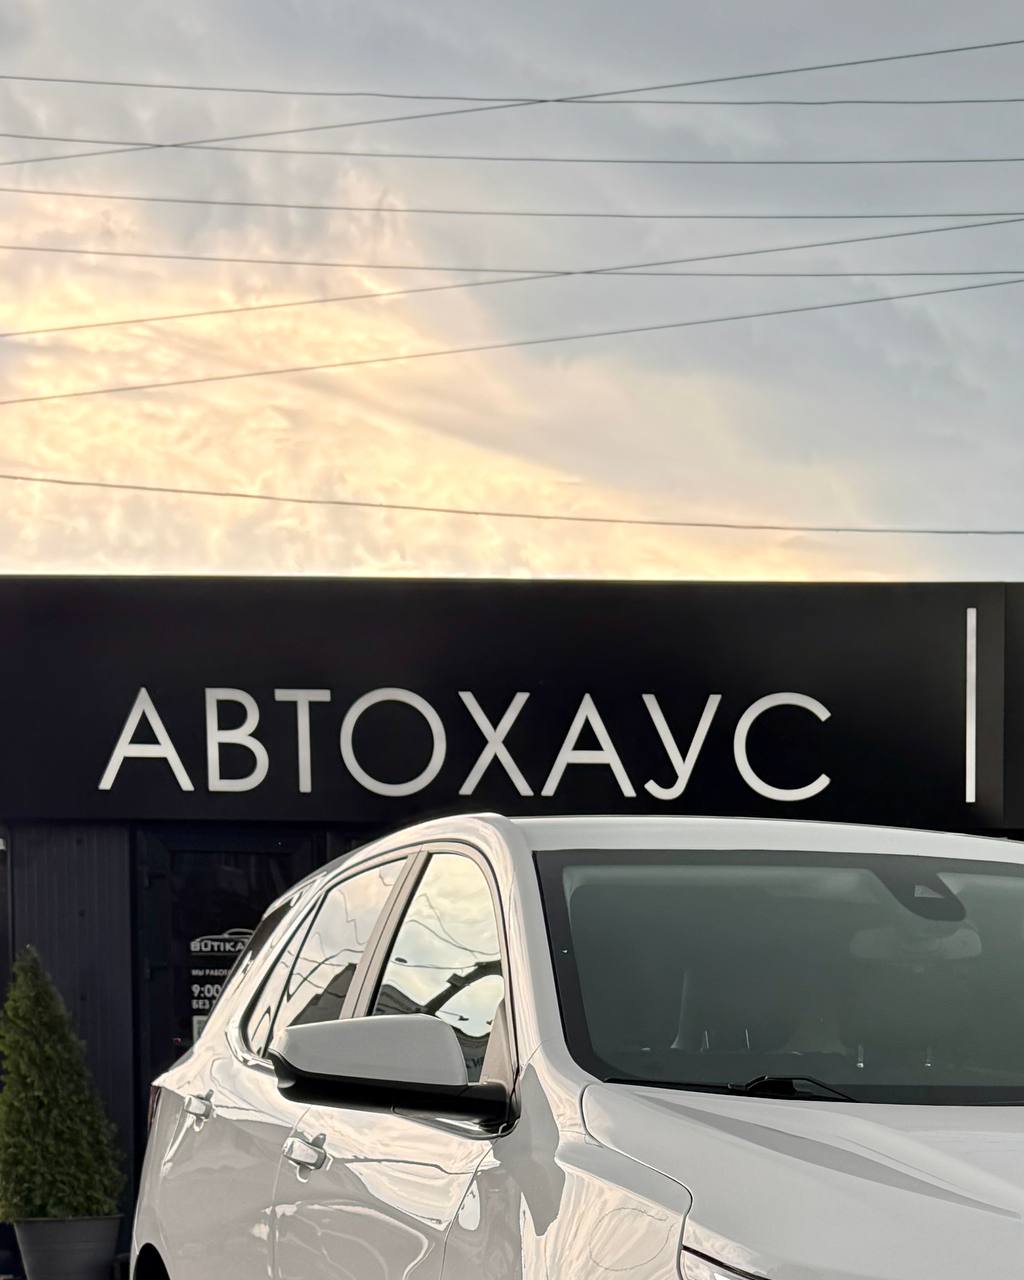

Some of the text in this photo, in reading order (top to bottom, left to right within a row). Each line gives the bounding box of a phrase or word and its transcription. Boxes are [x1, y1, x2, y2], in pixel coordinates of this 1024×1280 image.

[98, 686, 832, 802] АВТОХАУС
[190, 940, 245, 951] BUTIKA
[191, 984, 221, 998] 9:00
